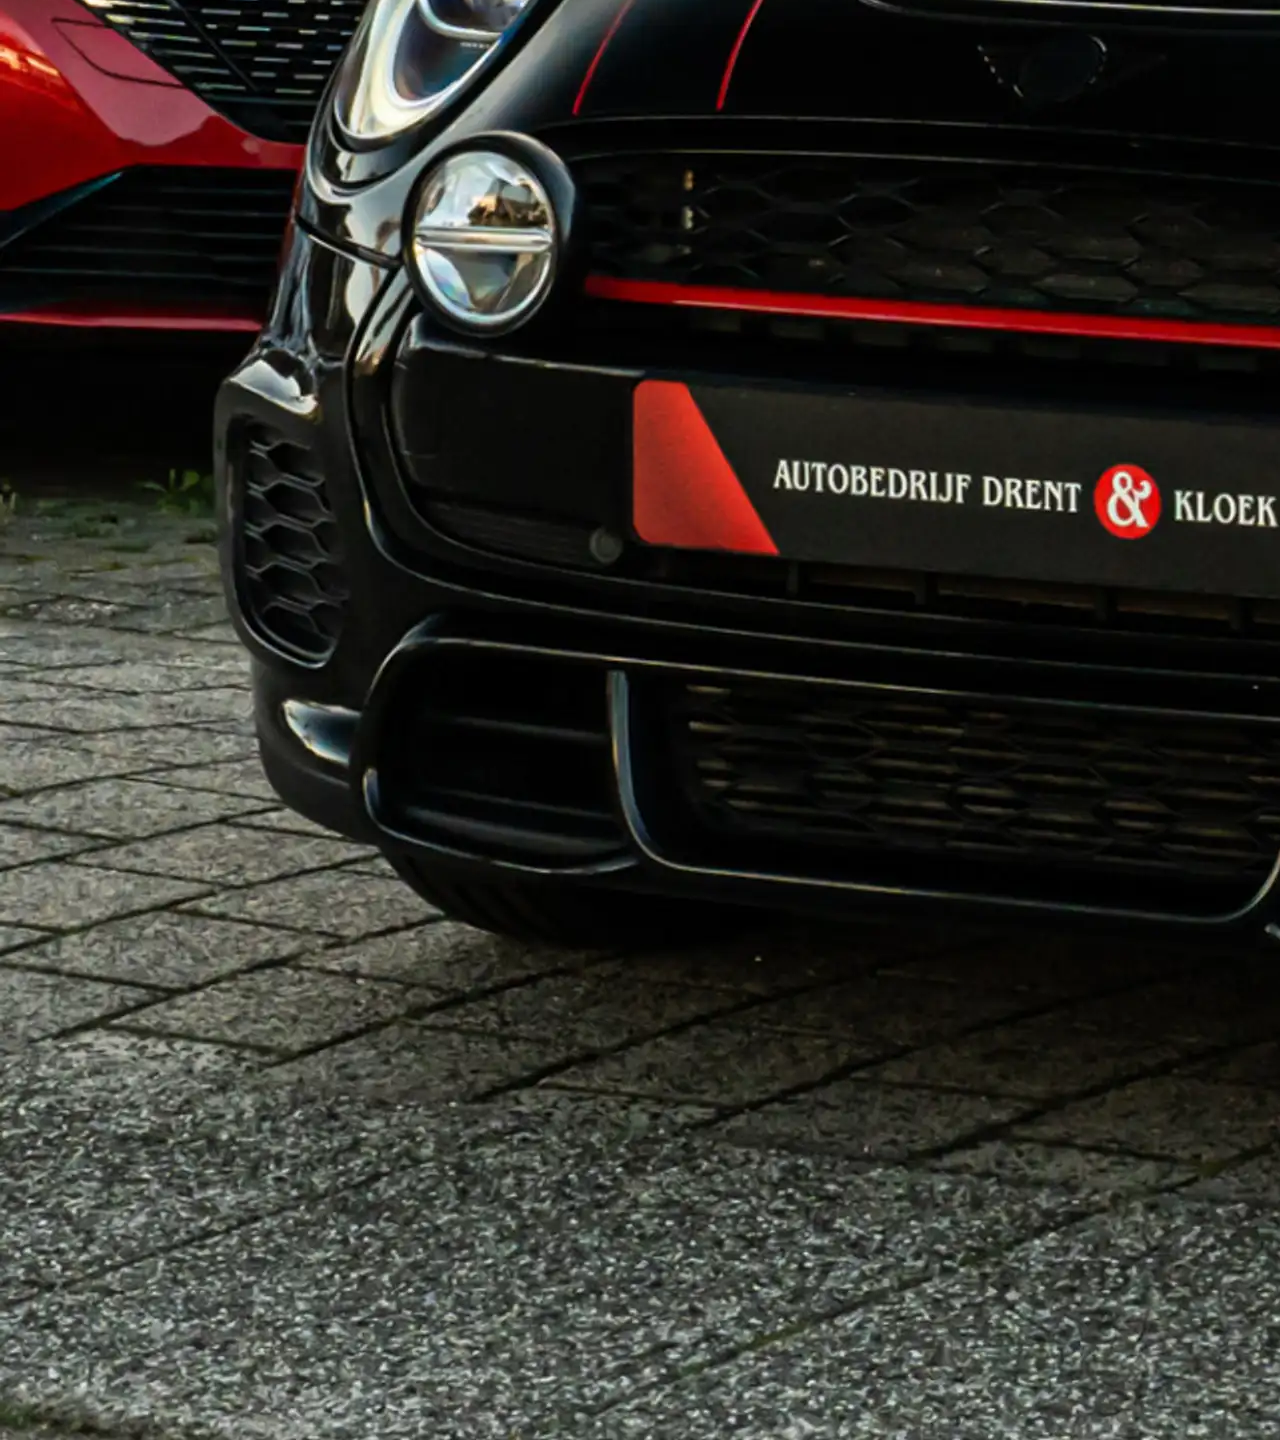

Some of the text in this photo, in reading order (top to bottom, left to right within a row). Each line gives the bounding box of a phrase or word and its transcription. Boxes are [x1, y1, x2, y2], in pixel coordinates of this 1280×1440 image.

[773, 459, 1279, 528] AUTOBEDRIJF DRENT & KLOEK
